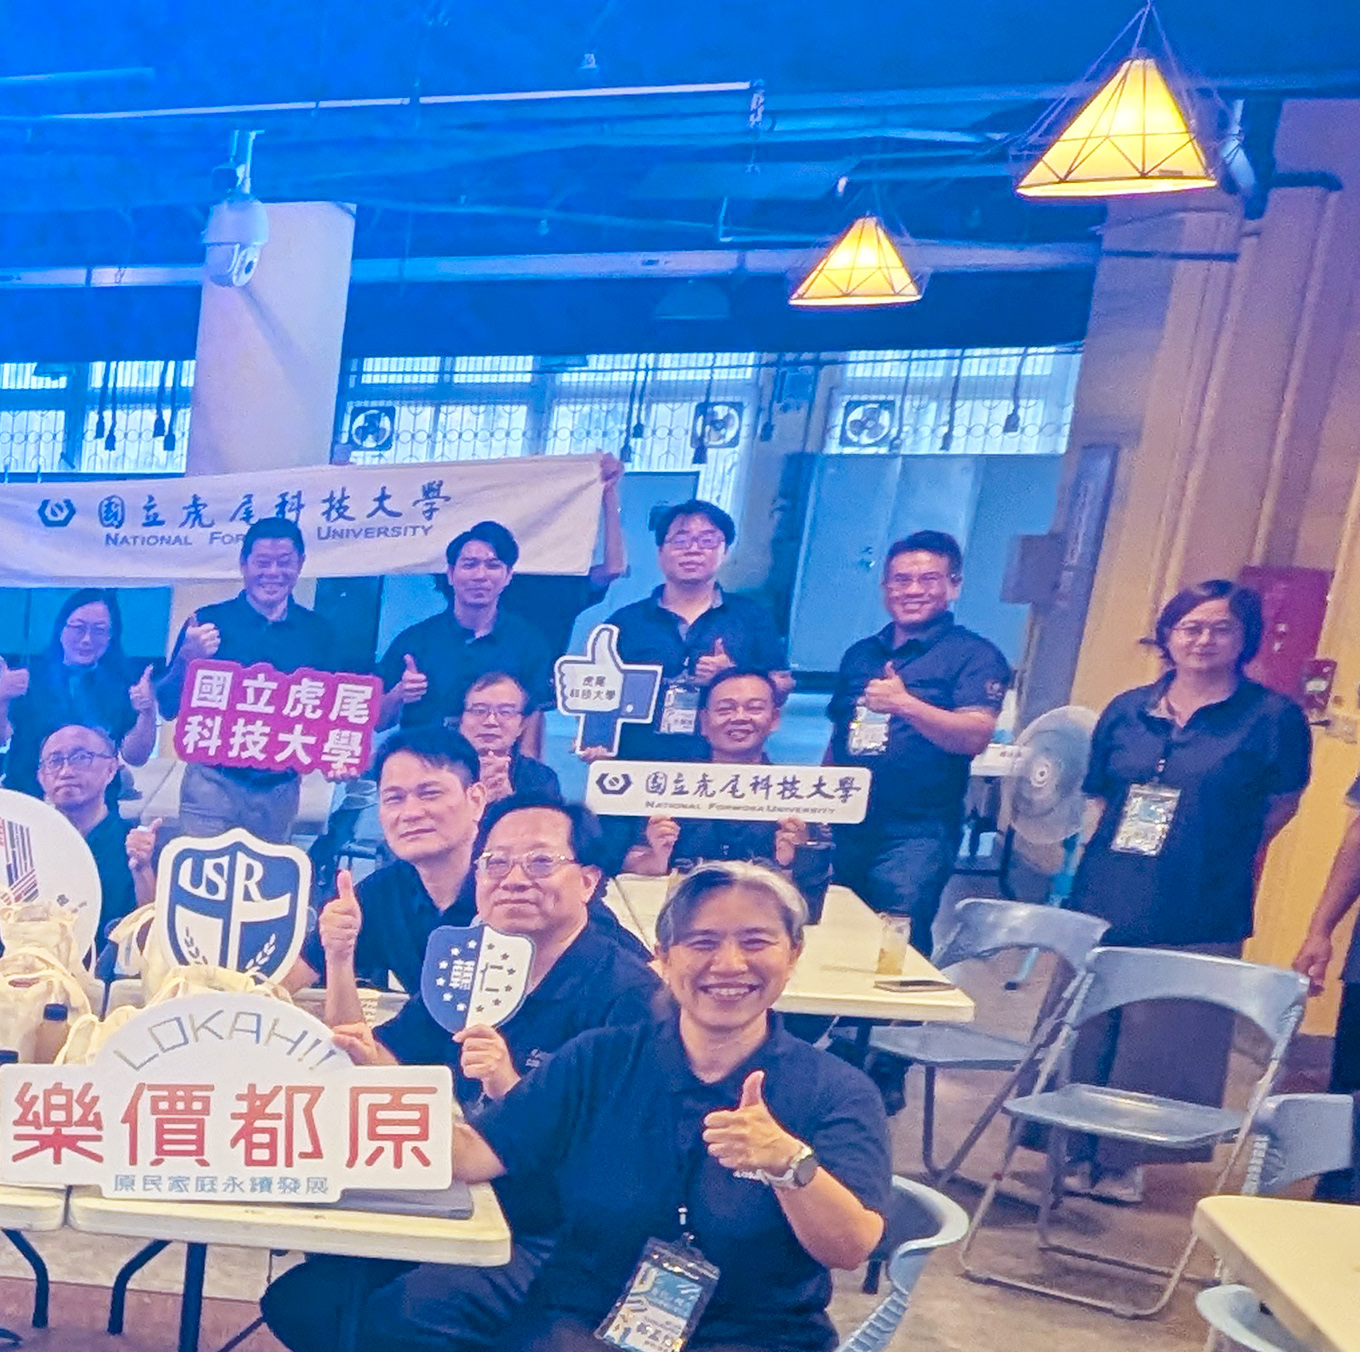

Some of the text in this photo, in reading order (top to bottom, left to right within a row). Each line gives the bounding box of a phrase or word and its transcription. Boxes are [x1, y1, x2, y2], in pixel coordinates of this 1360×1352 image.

[98, 479, 452, 529] 國立虎尾科技大學
[105, 533, 192, 546] NATIONAL
[317, 524, 434, 541] UNIVERSITY
[190, 669, 373, 724] 國立虎尾
[183, 715, 363, 770] 科技大學
[645, 772, 861, 803] 國立虎尾科技大學
[178, 850, 267, 902] USR
[11, 1081, 439, 1169] 樂價都原
[113, 1173, 330, 1195] 原民家庭永續發展
